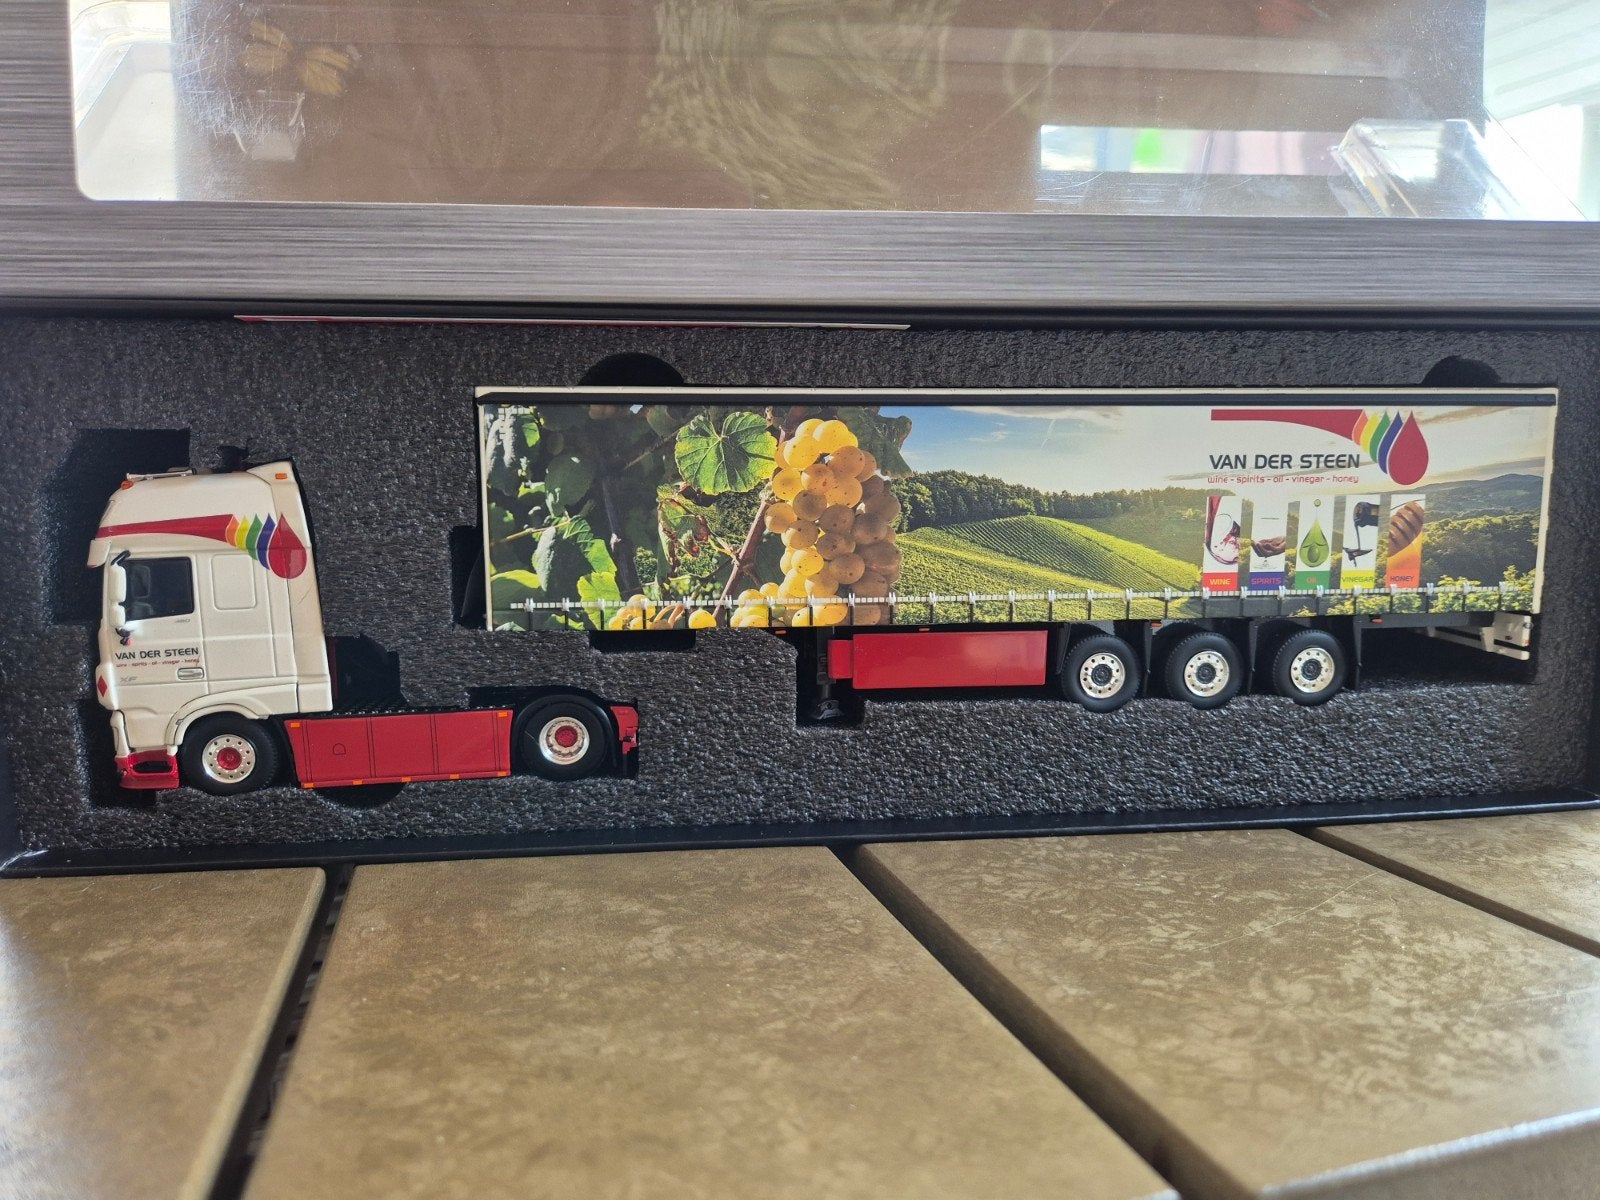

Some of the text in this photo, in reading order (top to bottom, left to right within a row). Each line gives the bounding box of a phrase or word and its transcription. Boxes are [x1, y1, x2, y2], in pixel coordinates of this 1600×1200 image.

[1209, 453, 1361, 470] VAN DER STEEN
[1207, 475, 1228, 484] wine
[1236, 475, 1265, 485] spirits
[1273, 475, 1284, 483] oil
[1291, 475, 1325, 485] vinegar
[1332, 475, 1359, 484] honey
[1209, 578, 1231, 586] WINE
[1251, 577, 1282, 585] SPIRITS
[115, 647, 199, 660] VAN DER STEEN
